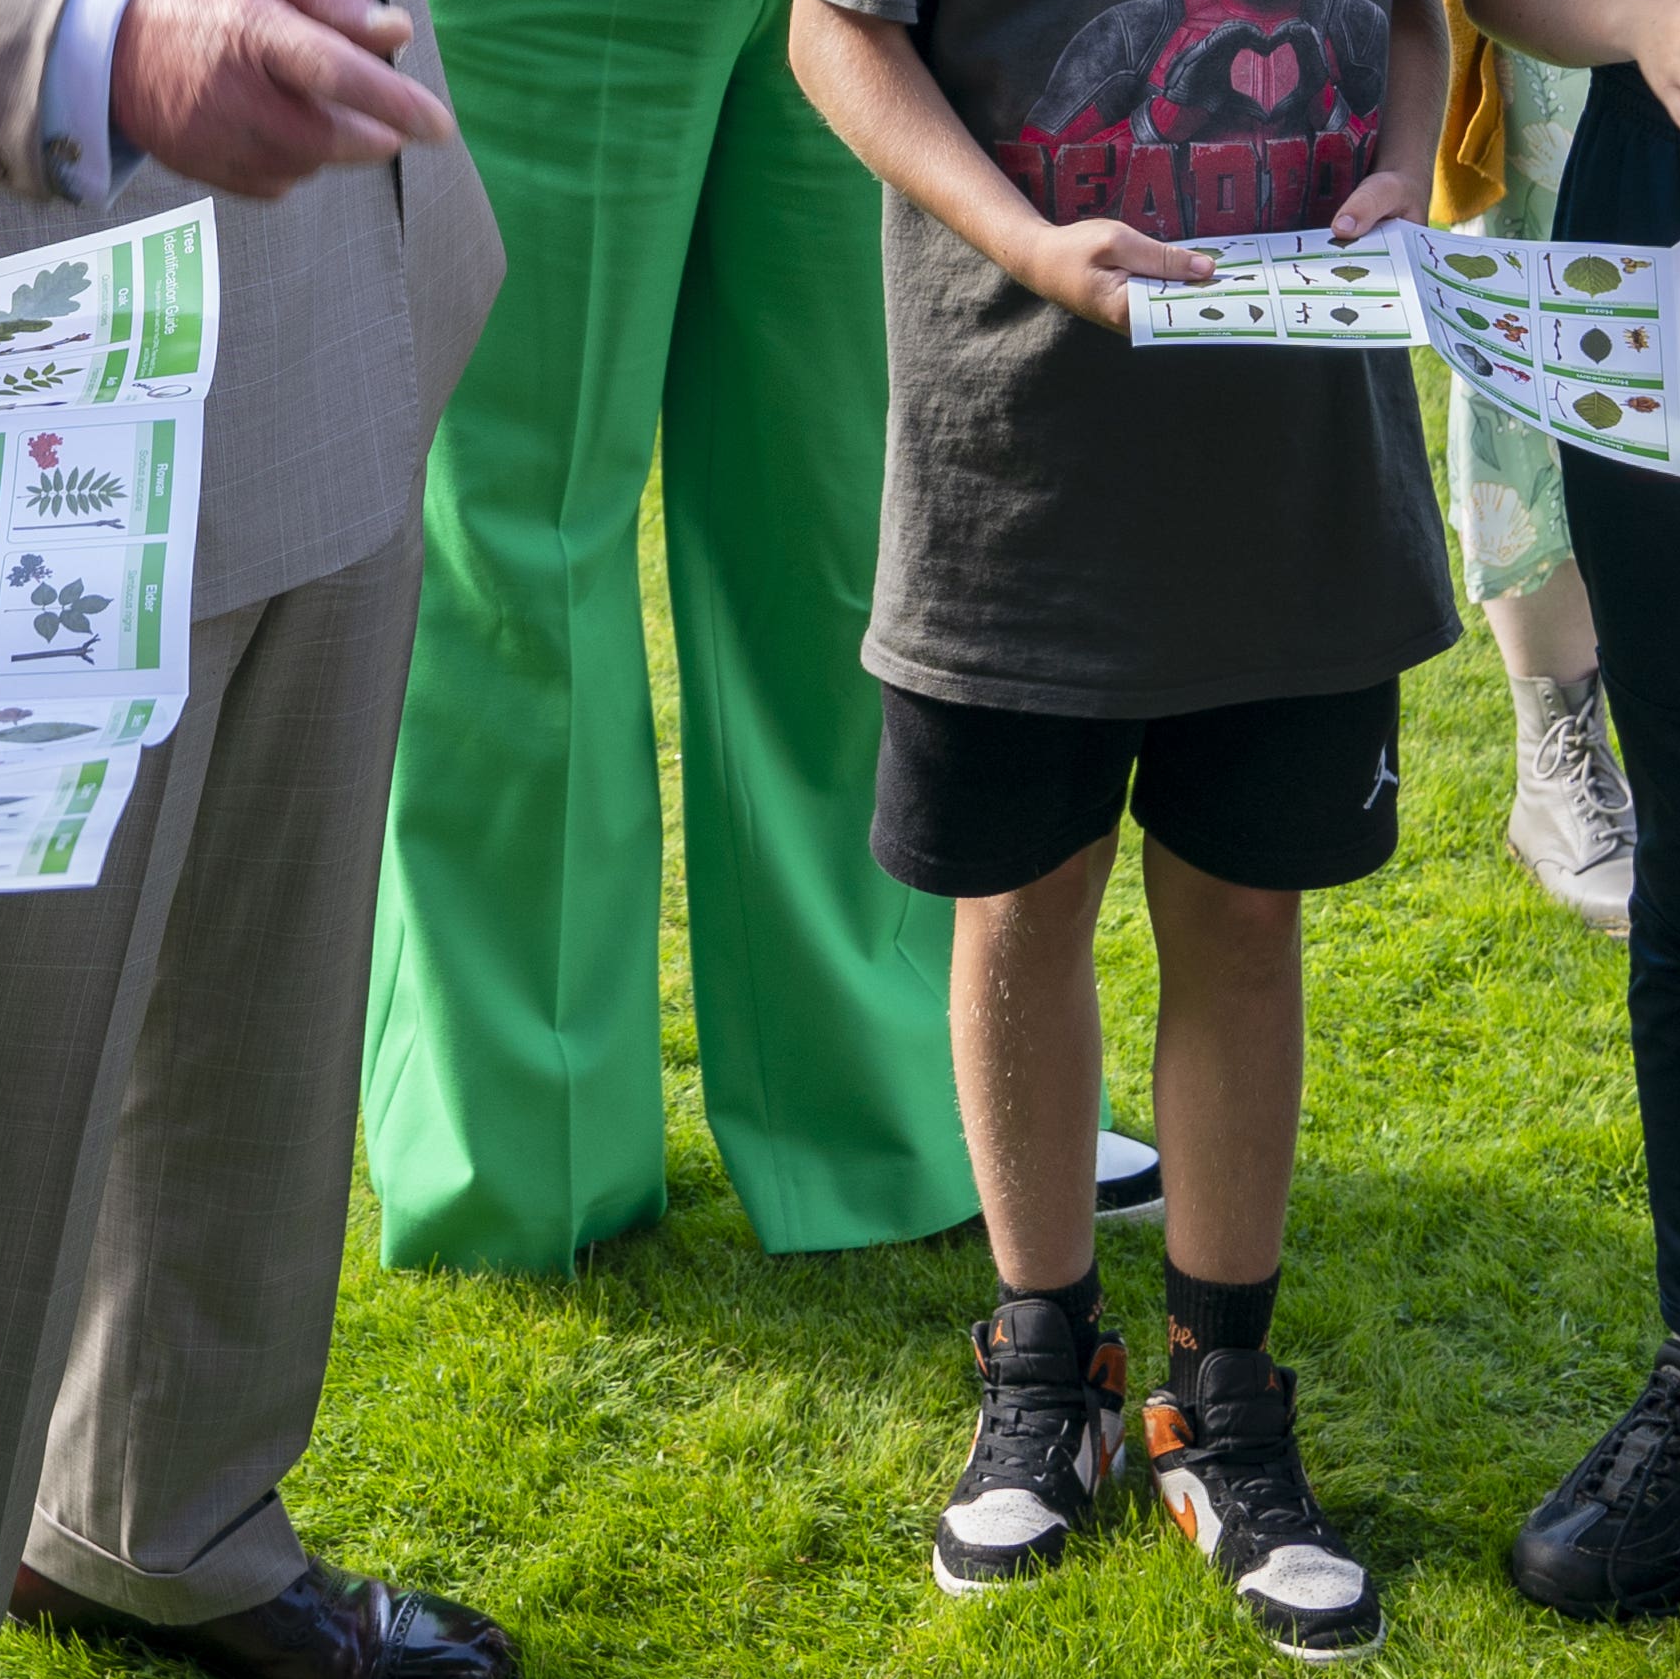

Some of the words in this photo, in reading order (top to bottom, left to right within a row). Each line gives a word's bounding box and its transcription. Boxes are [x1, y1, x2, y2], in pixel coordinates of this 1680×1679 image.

[183, 224, 197, 254] Tree
[164, 231, 180, 305] Identification
[117, 287, 129, 308] Oak
[1585, 307, 1614, 316] Hazel
[164, 305, 179, 335] Guide
[1576, 372, 1630, 386] Hornbeam
[154, 463, 169, 497] Rowan
[144, 584, 158, 613] Elder
